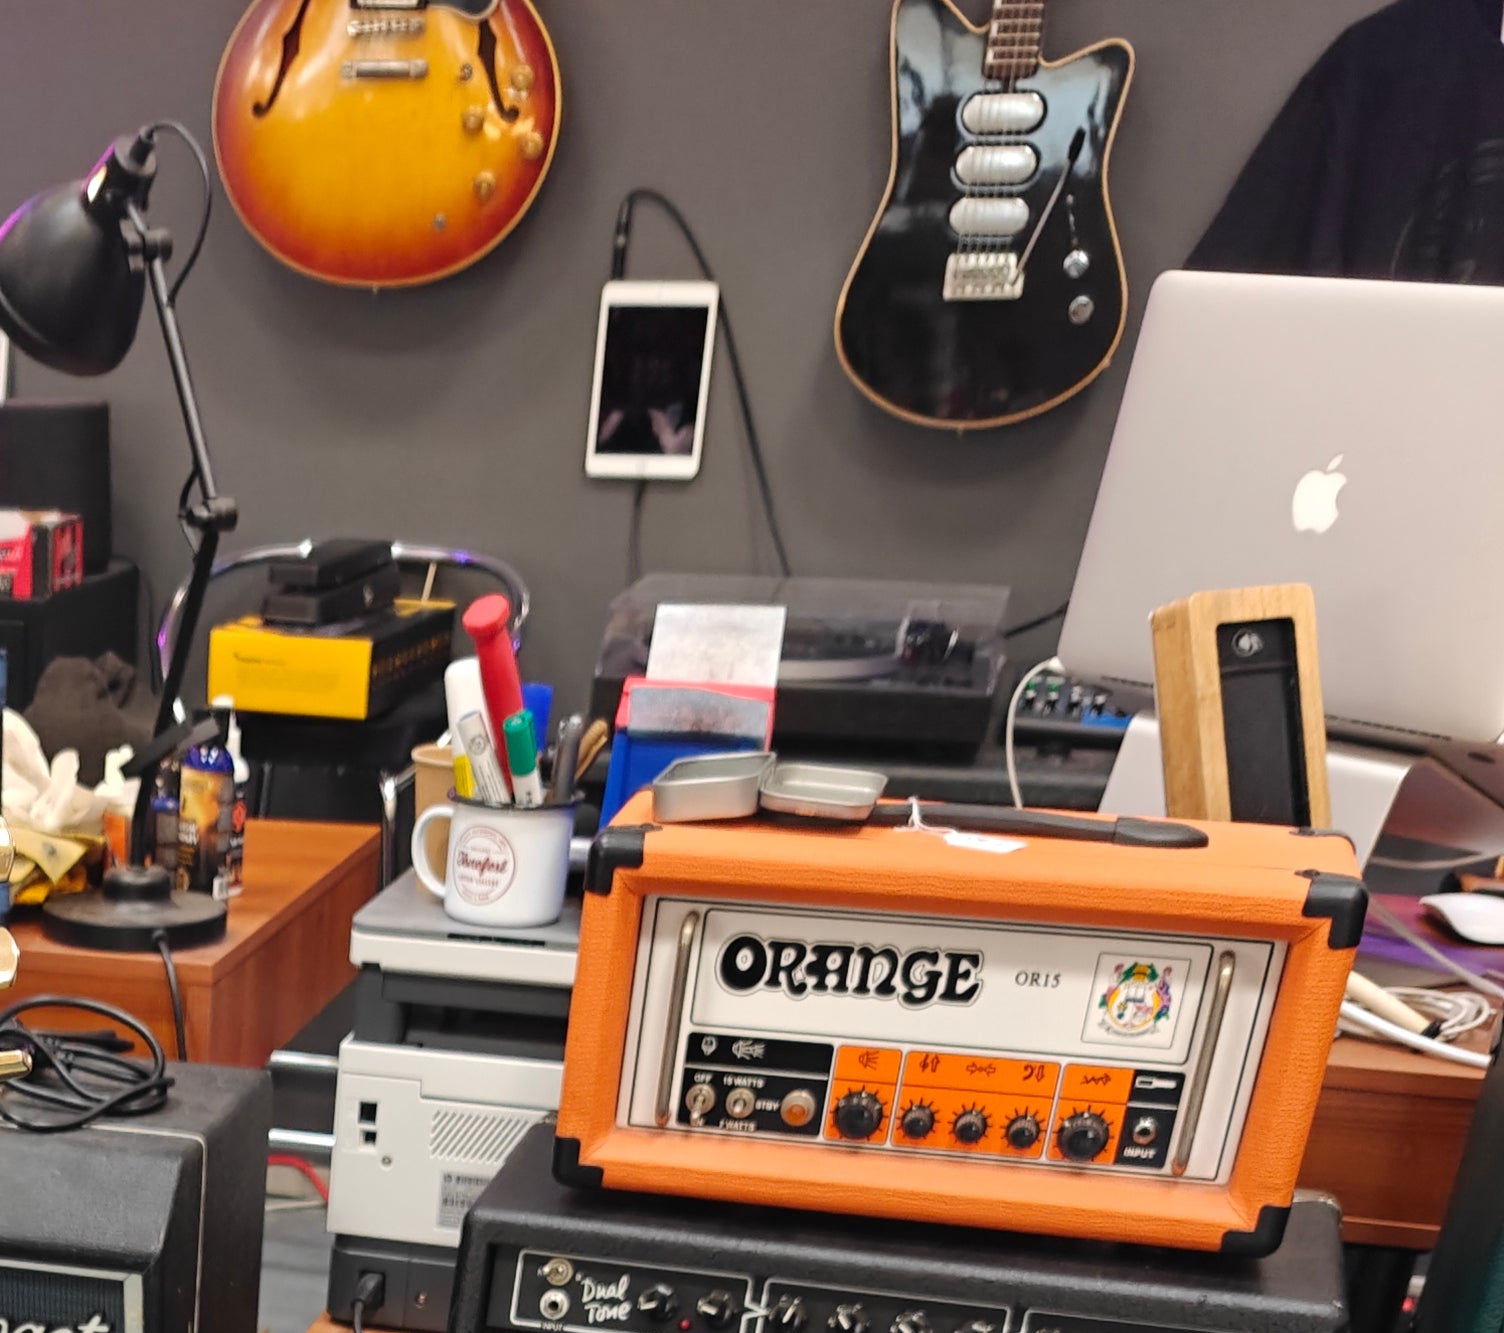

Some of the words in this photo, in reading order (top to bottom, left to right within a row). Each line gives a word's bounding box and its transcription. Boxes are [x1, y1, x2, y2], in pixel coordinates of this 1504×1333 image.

[720, 936, 982, 1004] ORANGE
[1014, 970, 1062, 988] OR15
[733, 1076, 765, 1089] WATTS
[755, 1099, 779, 1112] STBY
[725, 1120, 756, 1132] WATTS
[1123, 1147, 1156, 1159] INPUT
[584, 1301, 633, 1323] Tone
